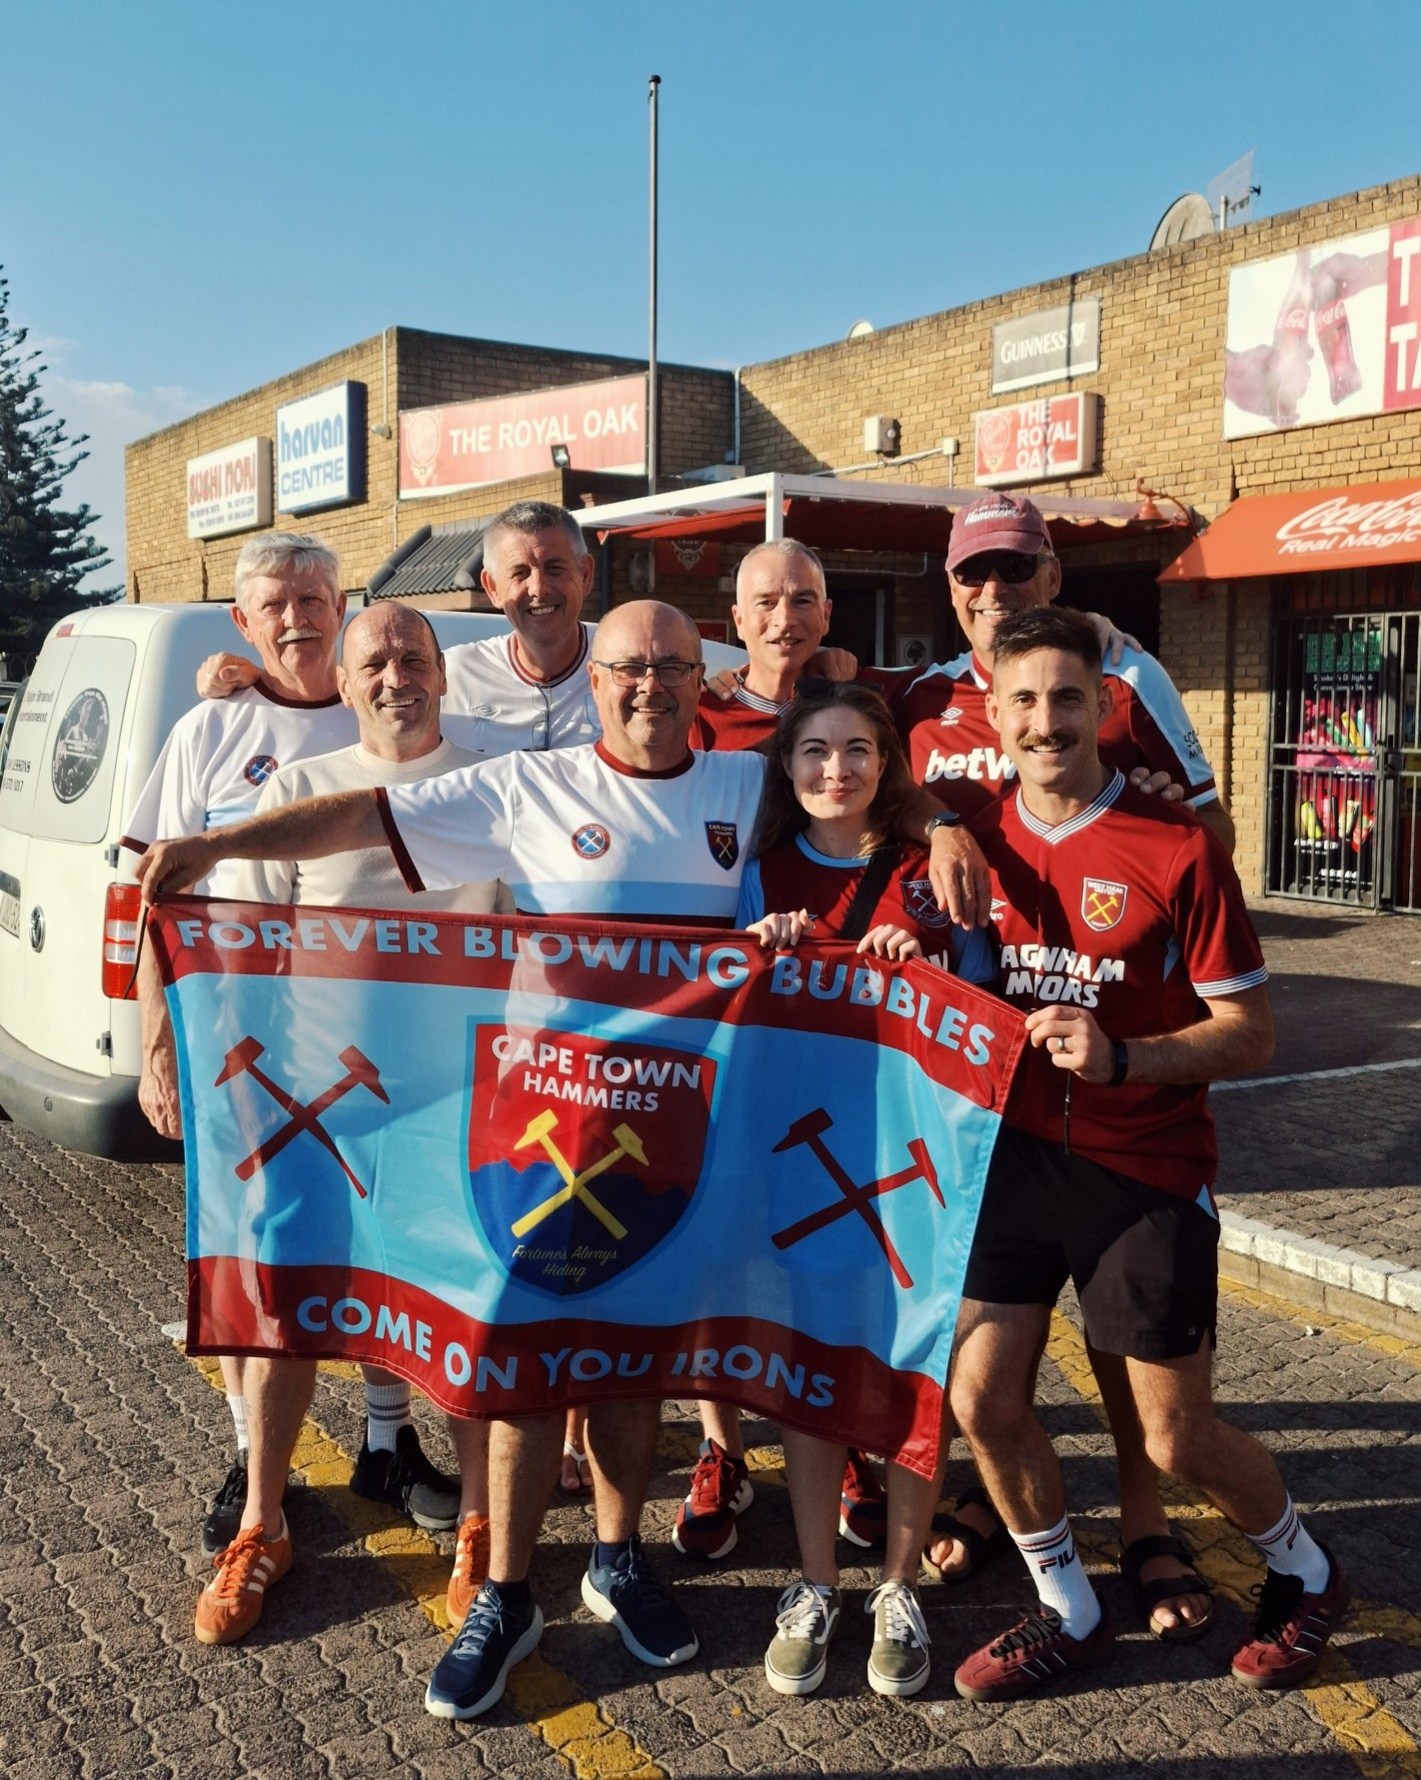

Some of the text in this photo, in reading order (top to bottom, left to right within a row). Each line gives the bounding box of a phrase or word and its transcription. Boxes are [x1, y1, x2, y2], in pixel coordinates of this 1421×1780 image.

[1001, 330, 1067, 364] GUINNESS
[1390, 321, 1421, 392] T
[448, 402, 639, 456] THE ROYAL OAK
[1016, 419, 1077, 449] ROYAL
[1017, 401, 1052, 428] THE
[280, 413, 344, 463] harvan
[1015, 444, 1055, 471] OAK
[189, 464, 222, 506] SUSHI
[280, 456, 345, 495] CENTRE
[1278, 527, 1421, 555] Real Magic
[176, 917, 996, 1066] FOREVER BLOWING BUBBLES
[491, 1034, 701, 1090] CAPE TOWN
[523, 1070, 660, 1113] HAMMERS
[541, 1262, 588, 1284] Hiding
[570, 1245, 618, 1267] Always
[296, 1295, 837, 1407] COME ON YOU IRONS
